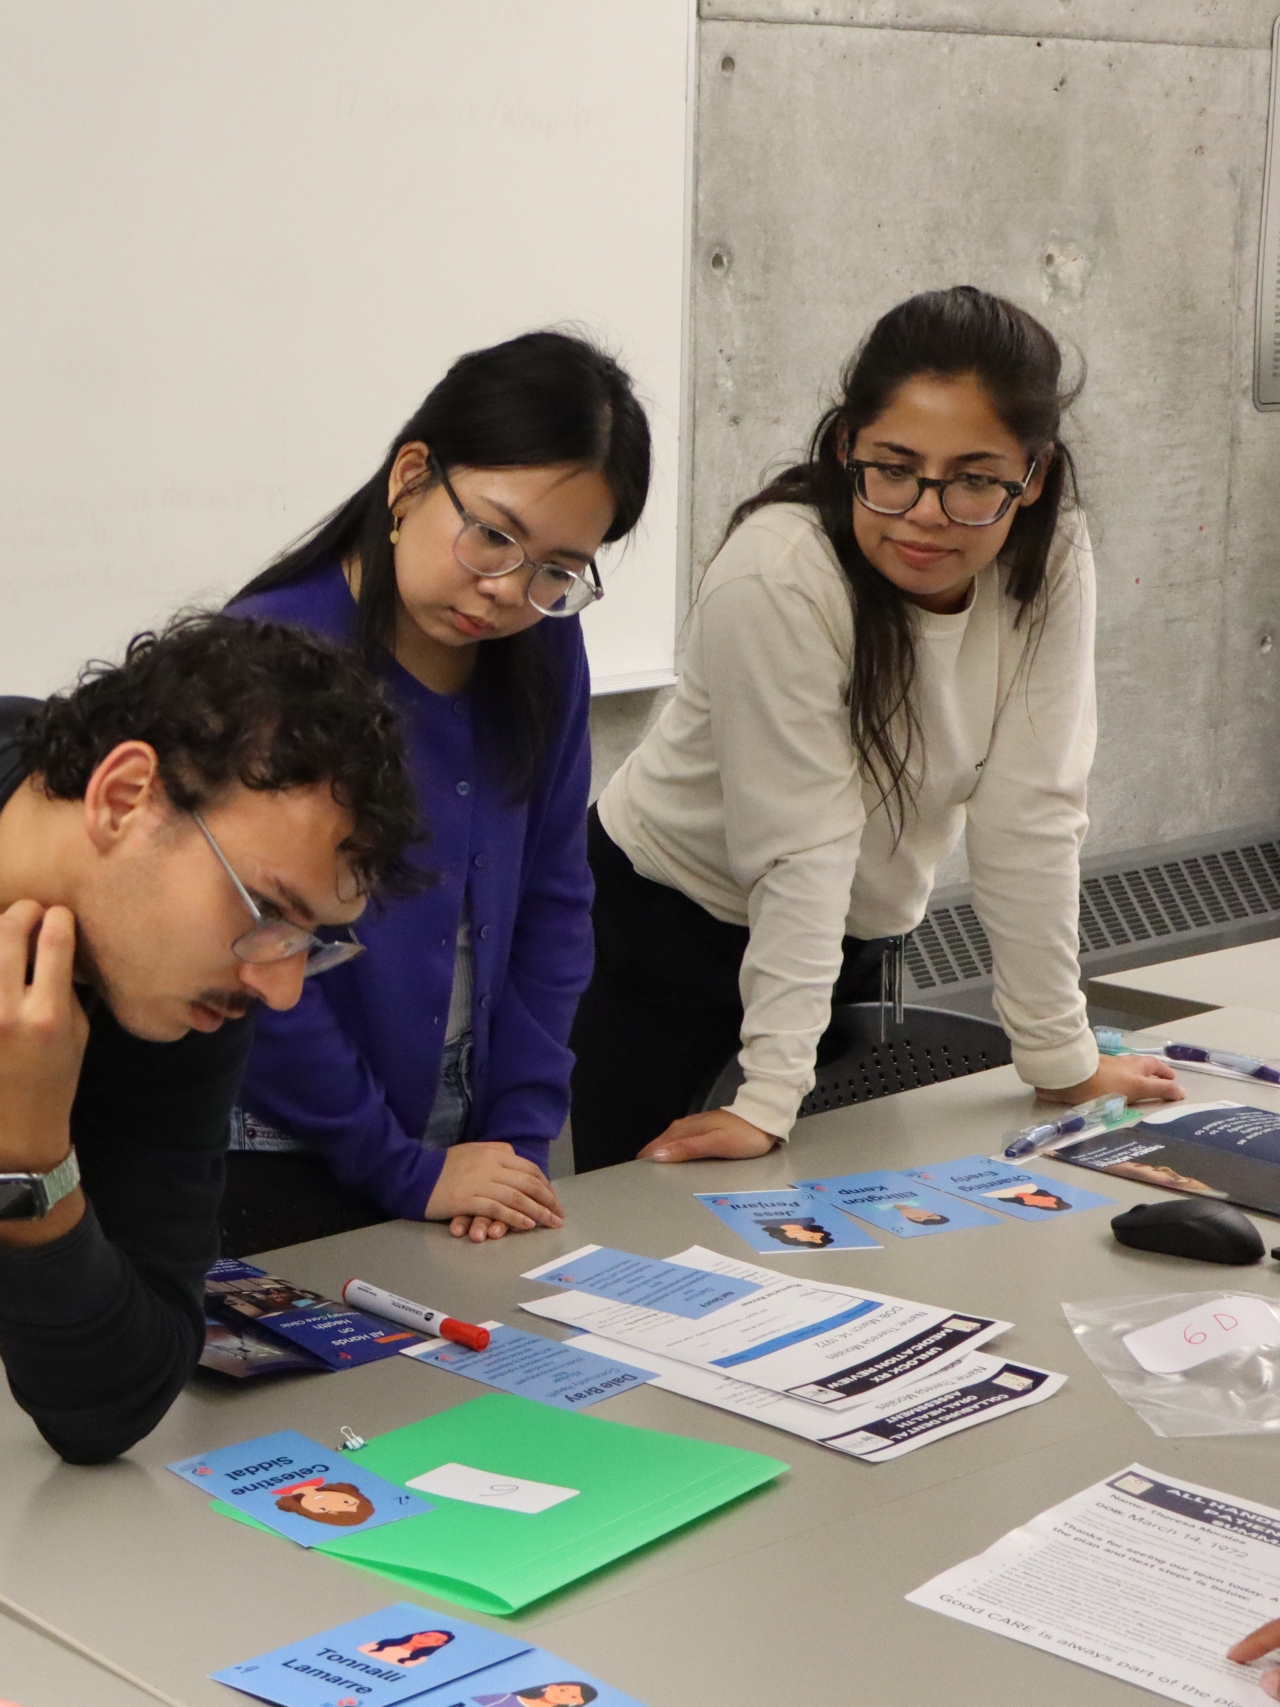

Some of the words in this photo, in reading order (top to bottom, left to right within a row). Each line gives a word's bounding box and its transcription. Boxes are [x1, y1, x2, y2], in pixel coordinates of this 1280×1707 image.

[944, 1170, 1001, 1183] Everly
[955, 1174, 1035, 1192] Channing
[834, 1184, 889, 1196] Kemp
[840, 1190, 919, 1206] Ellington
[728, 1200, 801, 1209] Penjani
[303, 1314, 328, 1323] Care
[872, 1306, 906, 1319] DOB:
[891, 1311, 929, 1326] Name:
[278, 1319, 306, 1329] Clinic
[312, 1317, 351, 1331] Health
[337, 1326, 355, 1334] on
[845, 1318, 882, 1332] March
[331, 1332, 370, 1348] Hands
[368, 1330, 386, 1338] All
[857, 1326, 901, 1344] Theresa
[811, 1337, 839, 1348] 1972
[868, 1328, 958, 1368] MEDICATION
[823, 1343, 865, 1360] Morales
[885, 1347, 944, 1373] UNLOCK
[570, 1367, 621, 1386] Community
[598, 1373, 638, 1389] Dale
[824, 1367, 876, 1389] REVIEW
[867, 1372, 892, 1382] RX
[949, 1366, 990, 1381] Name:
[543, 1385, 576, 1397] Health
[560, 1386, 604, 1402] Bray
[913, 1379, 956, 1395] Theresa
[873, 1393, 918, 1410] Morales
[882, 1390, 964, 1423] ASSESSMENT
[936, 1392, 1009, 1422] COLLABURG
[942, 1394, 977, 1408] ORAL
[894, 1407, 946, 1428] HEALTH
[887, 1418, 942, 1441] DENTAL
[224, 1456, 294, 1480] Siddal
[229, 1463, 331, 1497] Celestine
[1166, 1489, 1206, 1505] ALL
[1109, 1494, 1147, 1511] Name:
[1150, 1508, 1196, 1529] Theresa
[1199, 1525, 1246, 1546] Morales
[1095, 1501, 1125, 1518] DOB:
[1128, 1511, 1178, 1536] March
[1183, 1533, 1202, 1545] 14,
[1210, 1542, 1249, 1559] 1972
[1051, 1526, 1072, 1540] the
[1073, 1534, 1101, 1551] plan
[1104, 1544, 1128, 1560] and
[1130, 1554, 1158, 1570] next
[1159, 1563, 1193, 1583] steps
[1195, 1579, 1207, 1587] is
[1062, 1520, 1103, 1542] Thanks
[1106, 1537, 1124, 1551] for
[1125, 1545, 1166, 1567] seeing
[1168, 1559, 1194, 1572] our
[1195, 1565, 1227, 1585] team
[939, 1593, 984, 1616] Good
[987, 1610, 1038, 1635] CARE
[1039, 1629, 1054, 1643] is
[1056, 1637, 1114, 1665] always
[1115, 1659, 1155, 1681] part
[1157, 1676, 1181, 1687] of
[1182, 1683, 1211, 1699] the
[315, 1647, 407, 1684] Tonnalli
[281, 1658, 373, 1695] Lamarre
